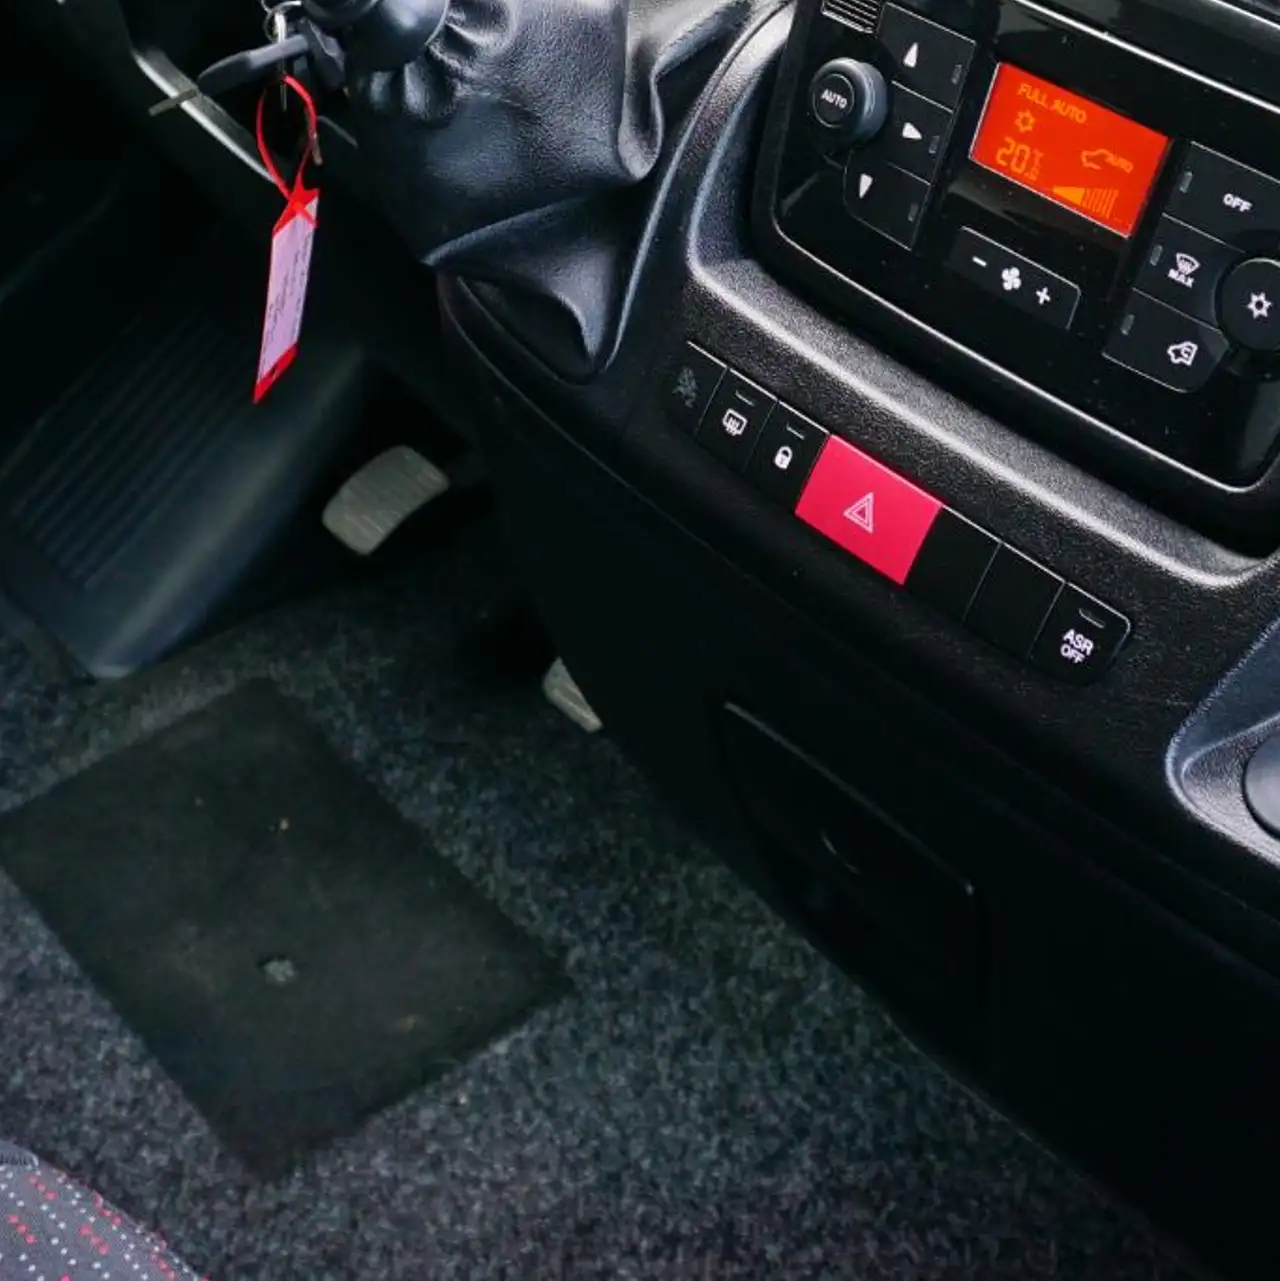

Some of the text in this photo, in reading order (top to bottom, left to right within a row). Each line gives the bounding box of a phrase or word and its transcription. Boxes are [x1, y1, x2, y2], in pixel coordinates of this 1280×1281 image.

[820, 88, 848, 109] AUTO
[1017, 83, 1088, 124] FULL AUTO
[1222, 193, 1253, 212] OFF
[1167, 268, 1195, 288] MAX
[1063, 628, 1094, 656] ASR
[1060, 643, 1086, 664] OFF
